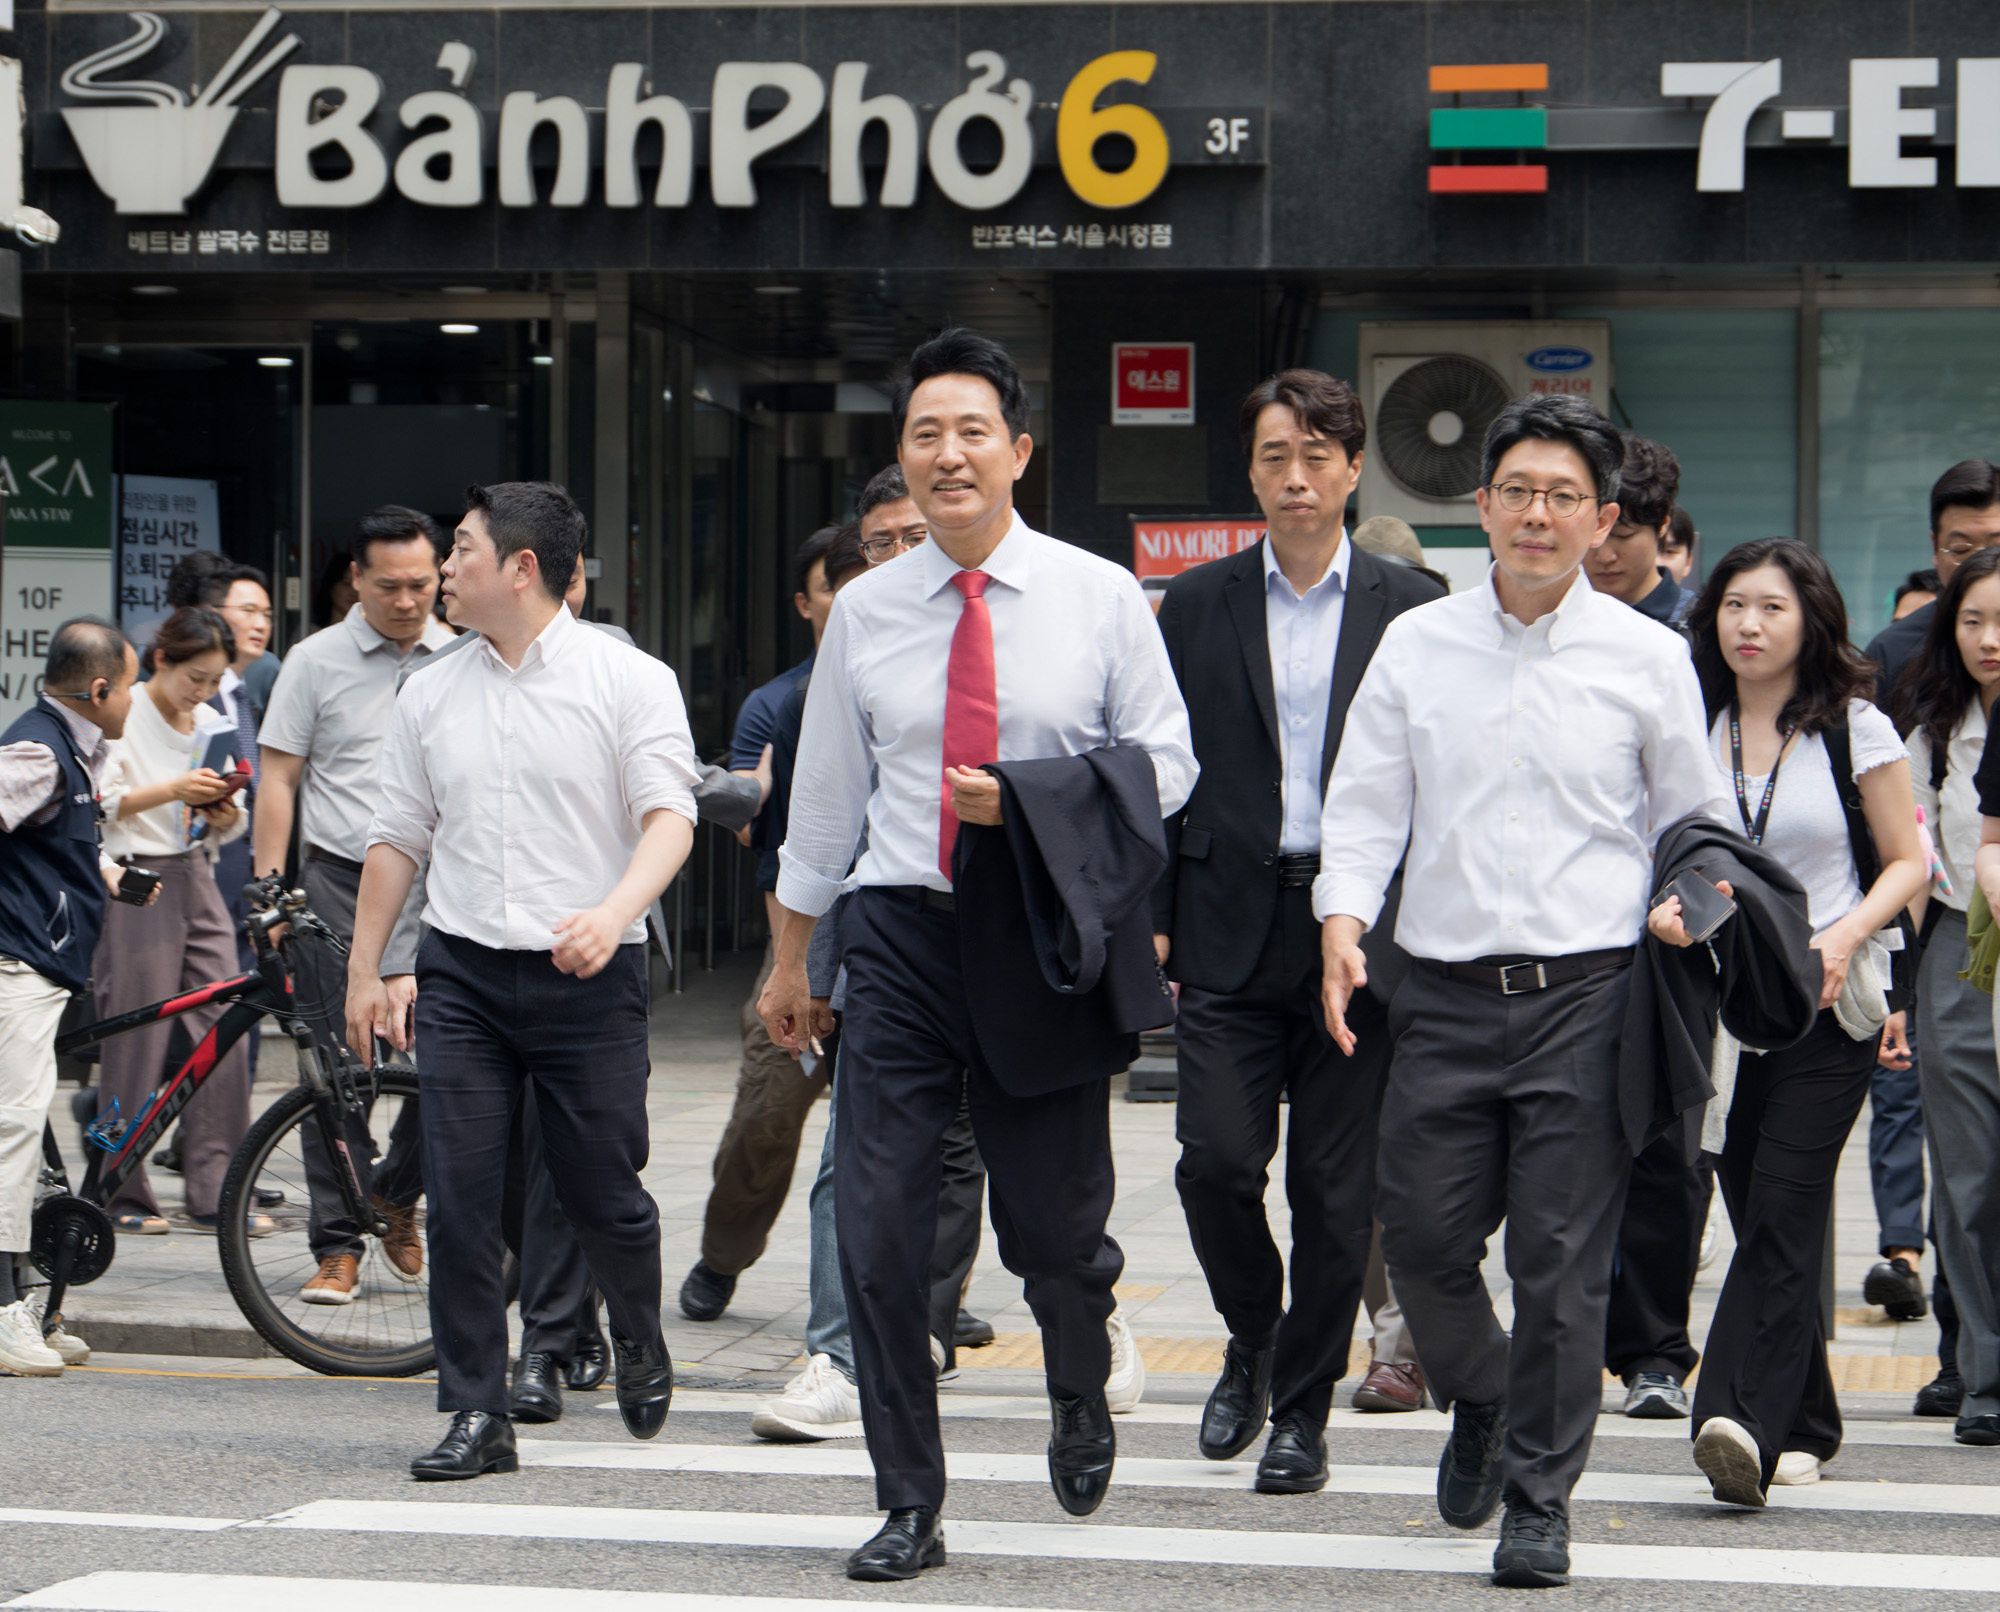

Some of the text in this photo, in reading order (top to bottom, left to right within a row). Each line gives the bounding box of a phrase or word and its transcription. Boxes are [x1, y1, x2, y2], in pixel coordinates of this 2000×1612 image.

[1056, 50, 1169, 209] 6
[1205, 118, 1250, 154] 3F
[128, 229, 330, 254] 베트남 쌀국수 전문점
[972, 223, 1174, 249] 반포식스 서울시청점
[41, 507, 74, 522] STAY
[122, 517, 198, 547] 점심시간
[123, 552, 186, 579] &퇴근
[18, 586, 63, 610] 10F
